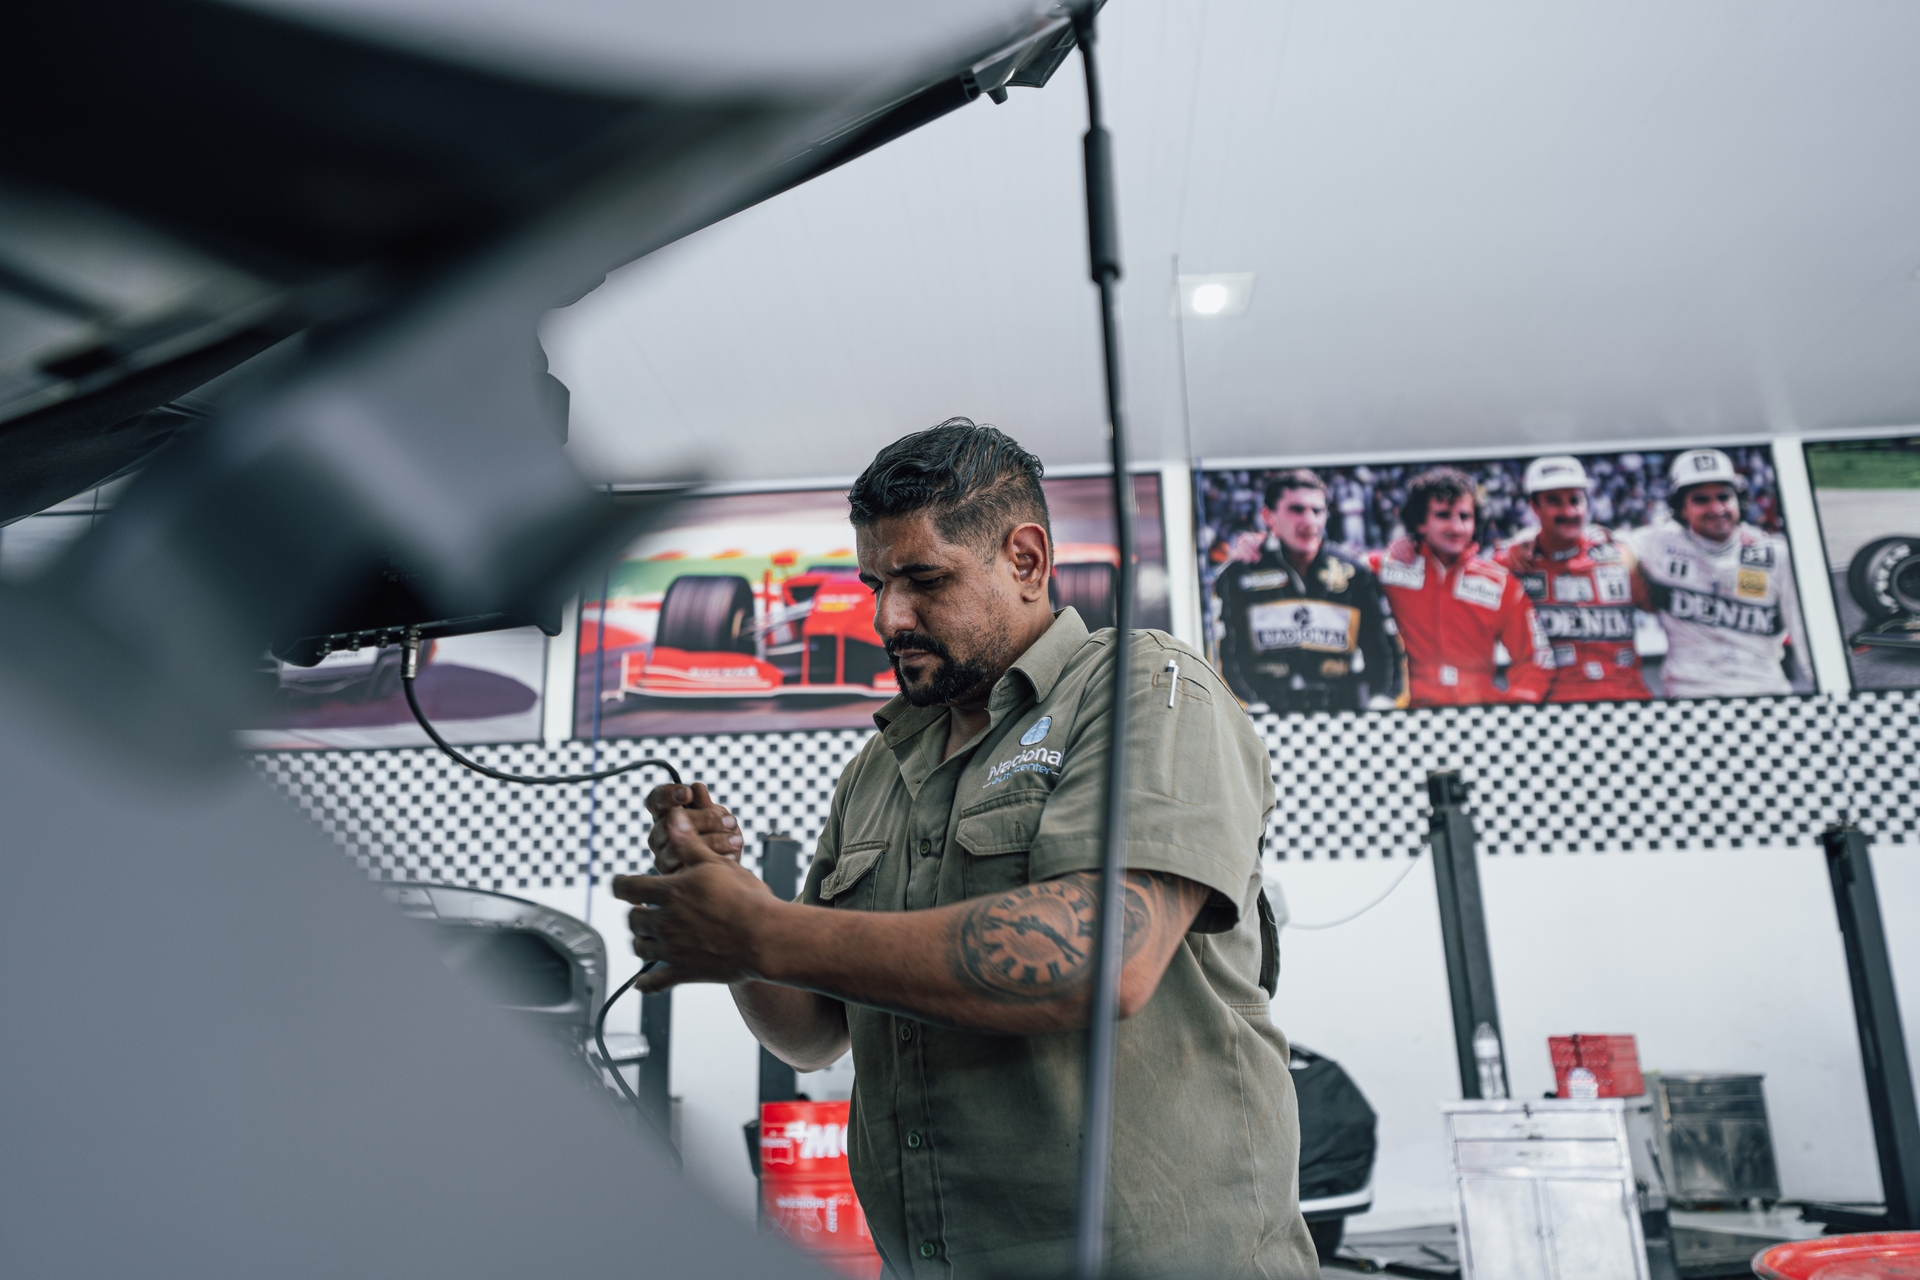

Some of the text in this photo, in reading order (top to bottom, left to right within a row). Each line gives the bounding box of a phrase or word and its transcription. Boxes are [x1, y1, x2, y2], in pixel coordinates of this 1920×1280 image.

[1540, 608, 1634, 637] DENIM
[1671, 589, 1775, 633] DENIM
[1014, 762, 1053, 775] center
